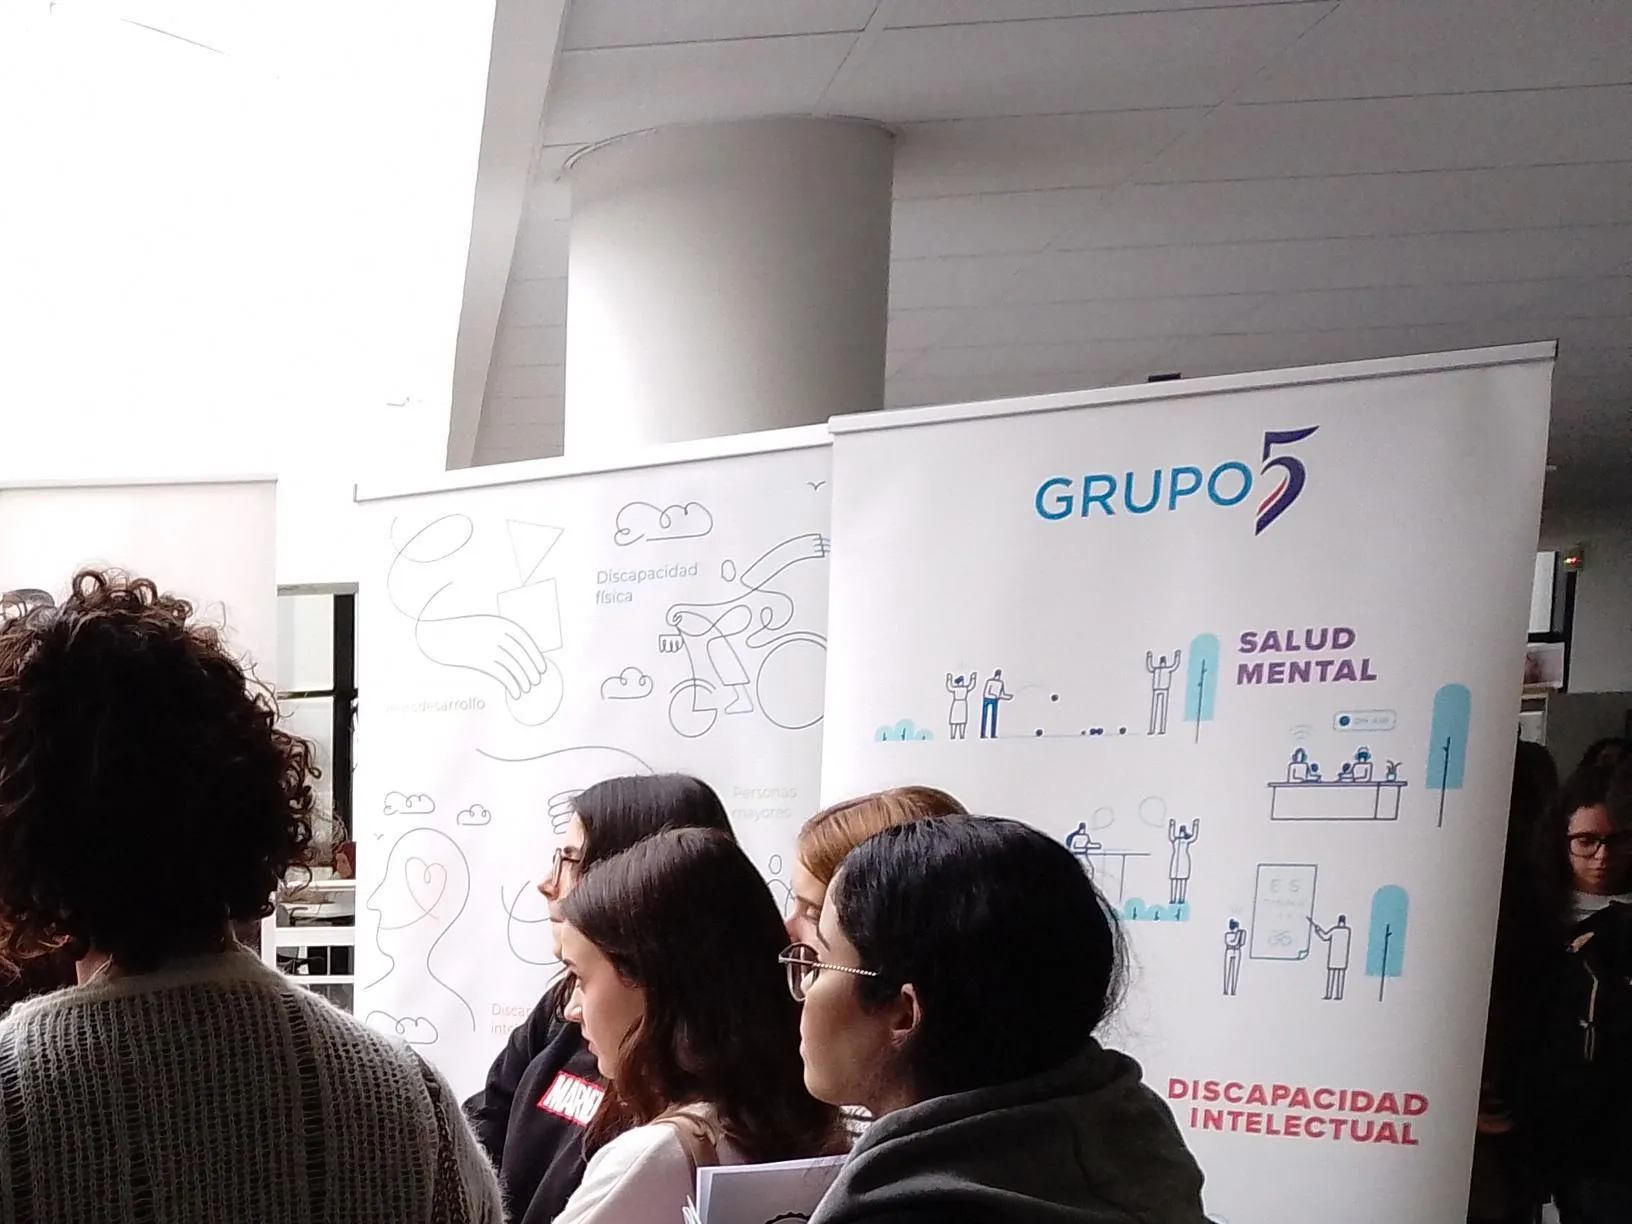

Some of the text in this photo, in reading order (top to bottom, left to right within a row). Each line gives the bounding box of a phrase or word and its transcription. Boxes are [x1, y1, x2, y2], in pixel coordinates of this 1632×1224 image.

[597, 562, 698, 584] Discapacidad
[596, 590, 633, 604] física
[1238, 627, 1357, 655] SALUD
[1236, 657, 1378, 685] MENTAL
[733, 785, 798, 799] Personas
[732, 806, 792, 822] mayores
[1167, 1078, 1429, 1117] DISCAPACIDAD
[1190, 1106, 1420, 1146] INTELECTUAL
